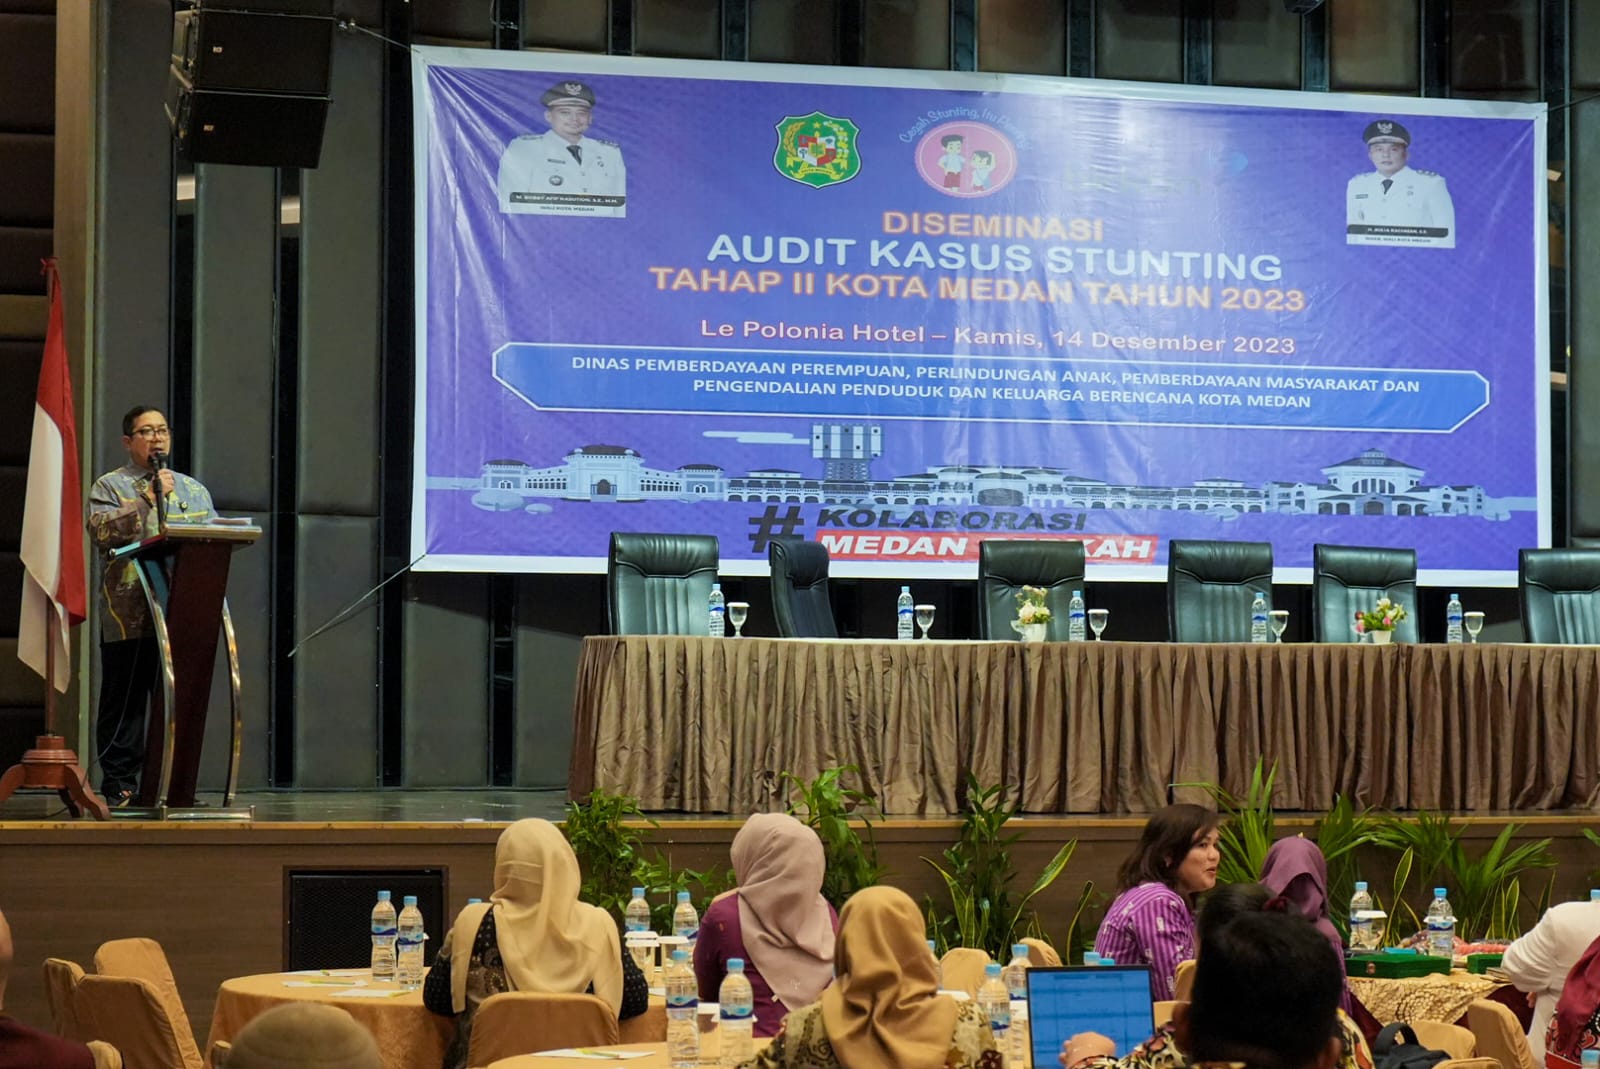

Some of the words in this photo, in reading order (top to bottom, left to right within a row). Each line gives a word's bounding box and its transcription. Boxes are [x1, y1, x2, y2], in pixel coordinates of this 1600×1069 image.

[883, 211, 1104, 242] DISEMINASI
[707, 234, 857, 266] AUDIT
[870, 239, 1033, 272] KASUS
[1047, 246, 1282, 281] STUNTING
[648, 266, 783, 295] TAHAP
[793, 272, 815, 296] II
[826, 272, 930, 299] KOTA
[938, 276, 1073, 305] MEDAN
[1081, 281, 1213, 309] TAHUN
[1220, 287, 1305, 312] 2023
[700, 319, 734, 338] Le
[743, 321, 845, 341] Polonia
[853, 324, 925, 343] Hotel
[953, 327, 1044, 350] Kamis,
[1053, 330, 1084, 347] 14
[1091, 331, 1226, 352] Desember
[1233, 335, 1296, 354] 2023
[571, 356, 631, 371] DINAS
[635, 358, 786, 375] PEMBERDAYAAN
[791, 364, 911, 381] PEREMPUAN,
[916, 366, 1057, 383] PERLINDUNGAN
[1061, 370, 1118, 386] ANAK,
[1122, 372, 1261, 389] PEMBERDAYAAN
[1266, 376, 1379, 392] MASYARAKAT
[1383, 380, 1420, 393] DAN
[693, 379, 837, 396] PENGENDALIAN
[841, 383, 944, 399] PENDUDUK
[949, 386, 988, 400] DAN
[992, 387, 1084, 402] KELUARGA
[1090, 390, 1194, 406] BERENCANA
[1199, 393, 1243, 407] KOTA
[1247, 394, 1311, 409] MEDAN
[816, 509, 1088, 532] KOLABORASI
[819, 535, 969, 556] MEDAN
